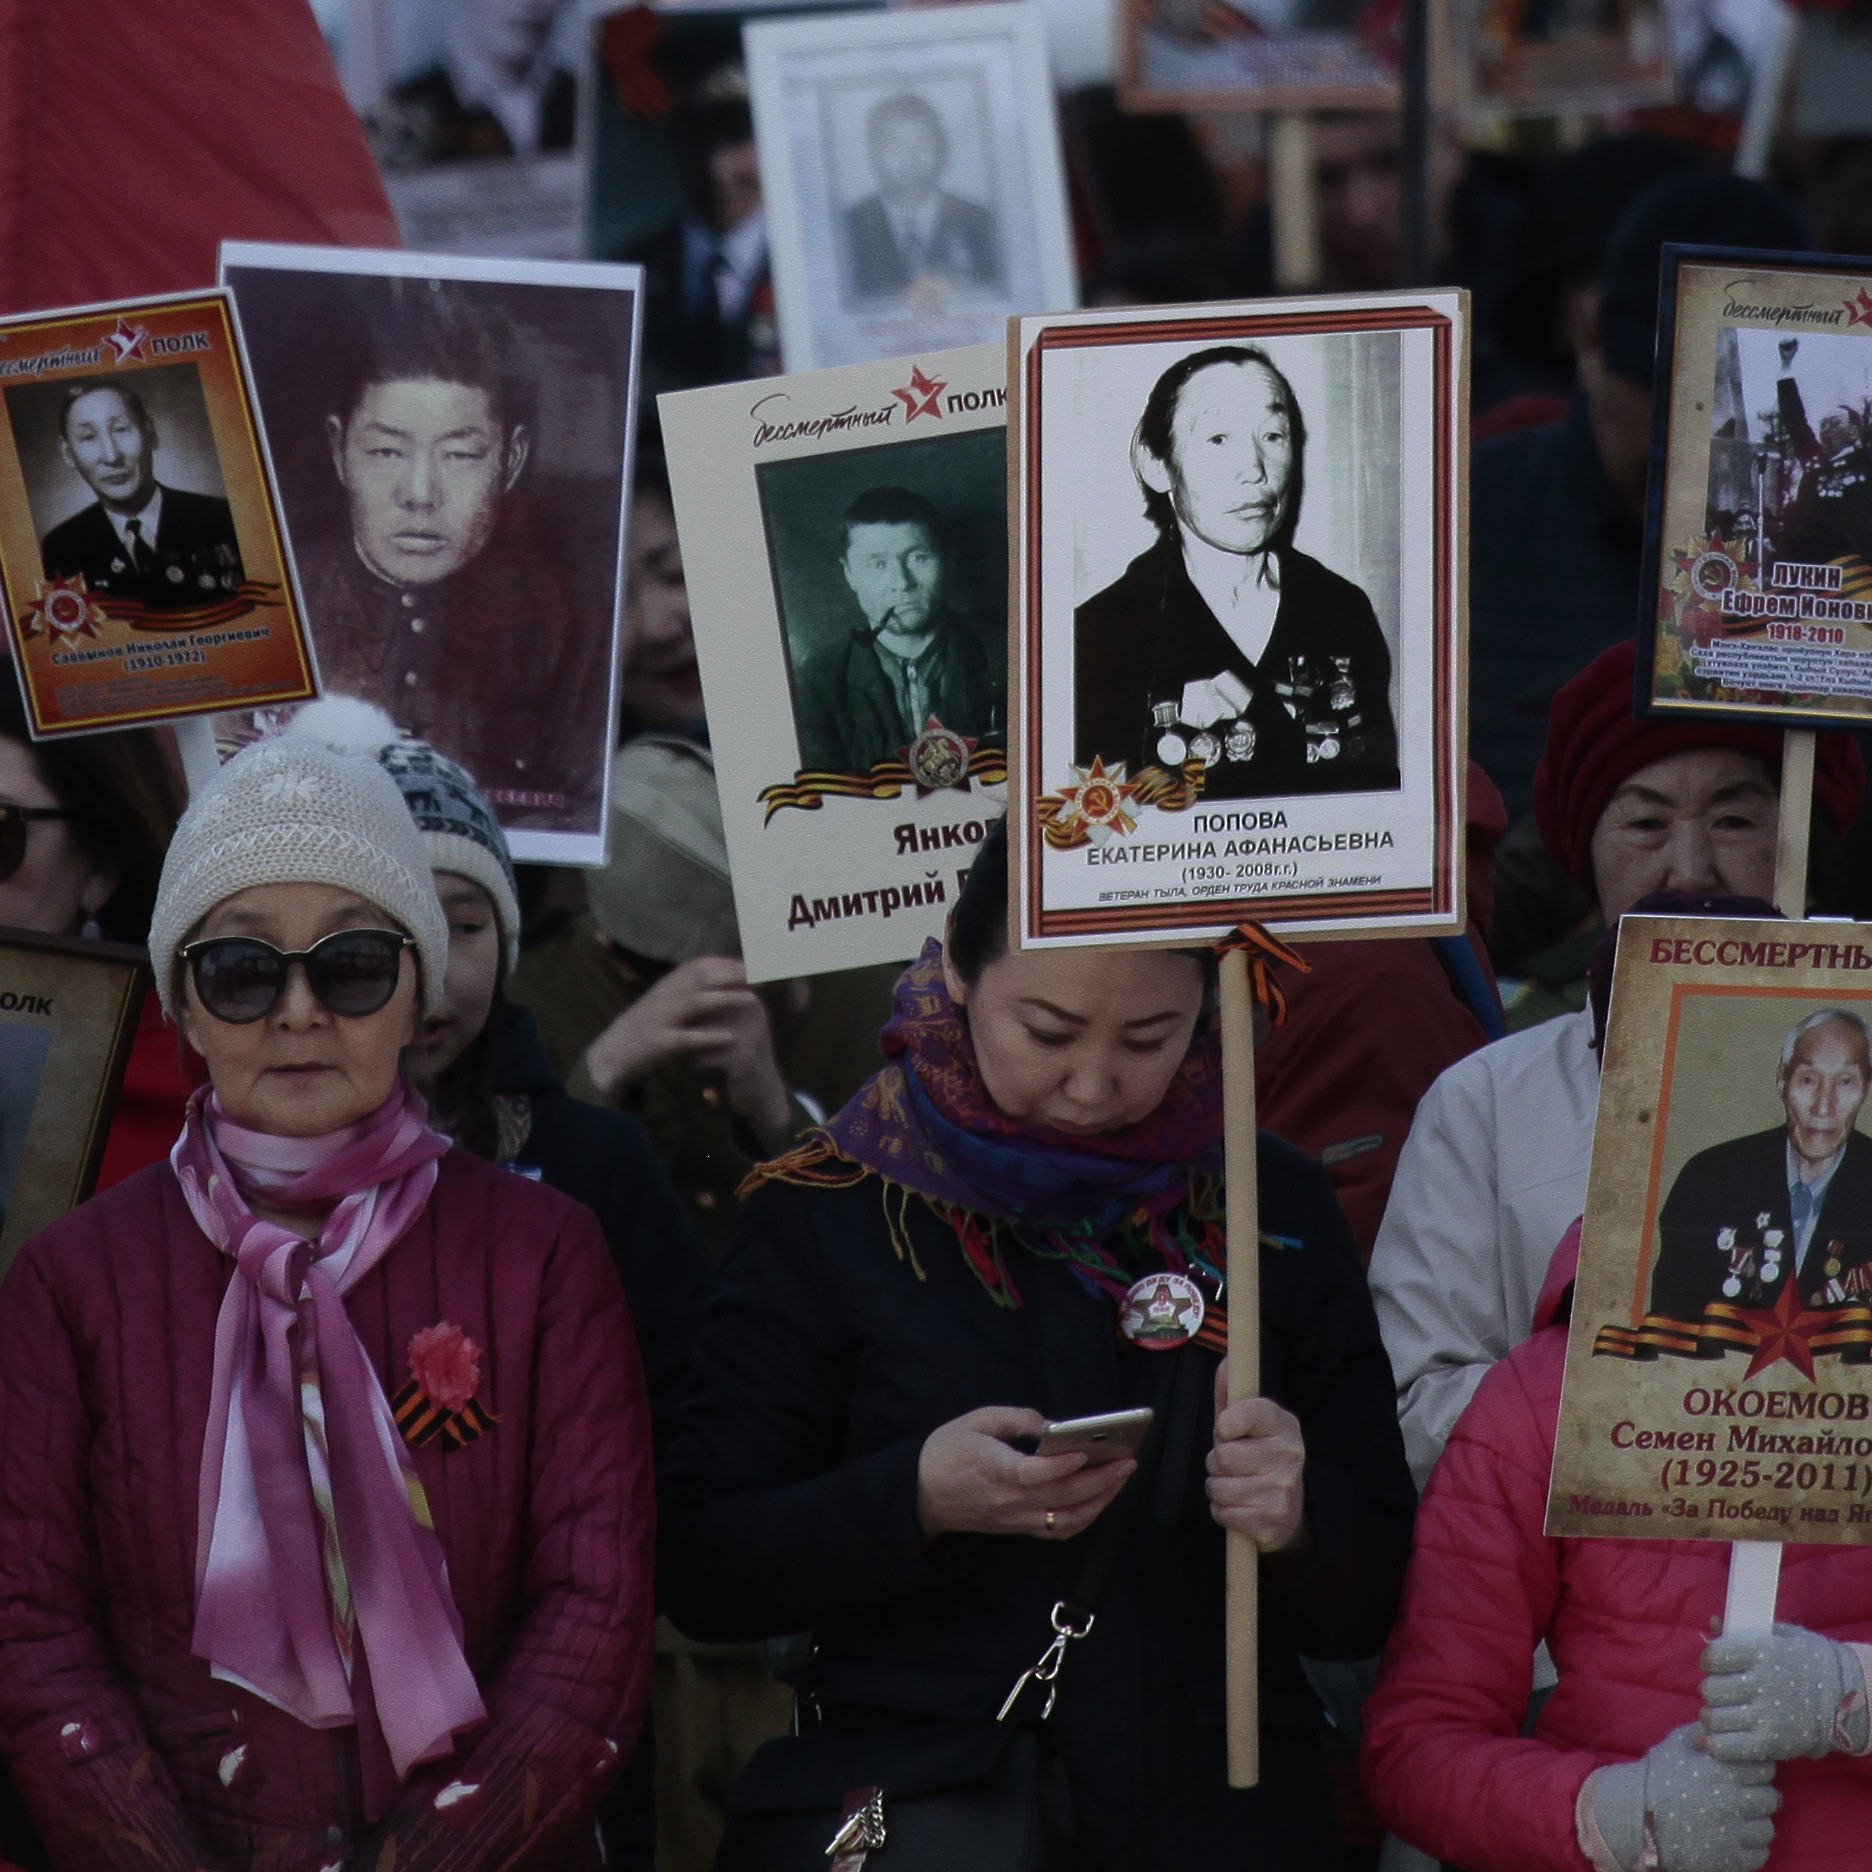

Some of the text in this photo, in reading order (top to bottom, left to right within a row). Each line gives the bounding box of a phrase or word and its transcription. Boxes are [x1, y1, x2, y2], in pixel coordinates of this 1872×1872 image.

[1722, 279, 1845, 326] бессмертный
[151, 331, 211, 354] ПОЛК
[750, 393, 898, 447] бессмертный
[1773, 563, 1842, 589] ЛУКИН
[1722, 589, 1796, 617] Ефрем
[1193, 811, 1288, 833] ПОПОВА
[1086, 831, 1394, 866] ЕКАТЕРИНА АФАНАСЬЕВНА
[1098, 875, 1382, 902] ВЕТЕРАН ТЫЛА, ОРДЕН ТРУДА КРАСНОЙ ЗНАМЕНИ
[1181, 866, 1230, 883] (1930-
[788, 870, 946, 931] Дмитрий
[1682, 1387, 1871, 1421] ОКОЕМОВ
[1609, 1421, 1716, 1453] Семен
[1568, 1493, 1654, 1517] Медаль
[1661, 1497, 1699, 1518] «За
[1705, 1498, 1793, 1524] Победу
[1799, 1505, 1840, 1524] над
